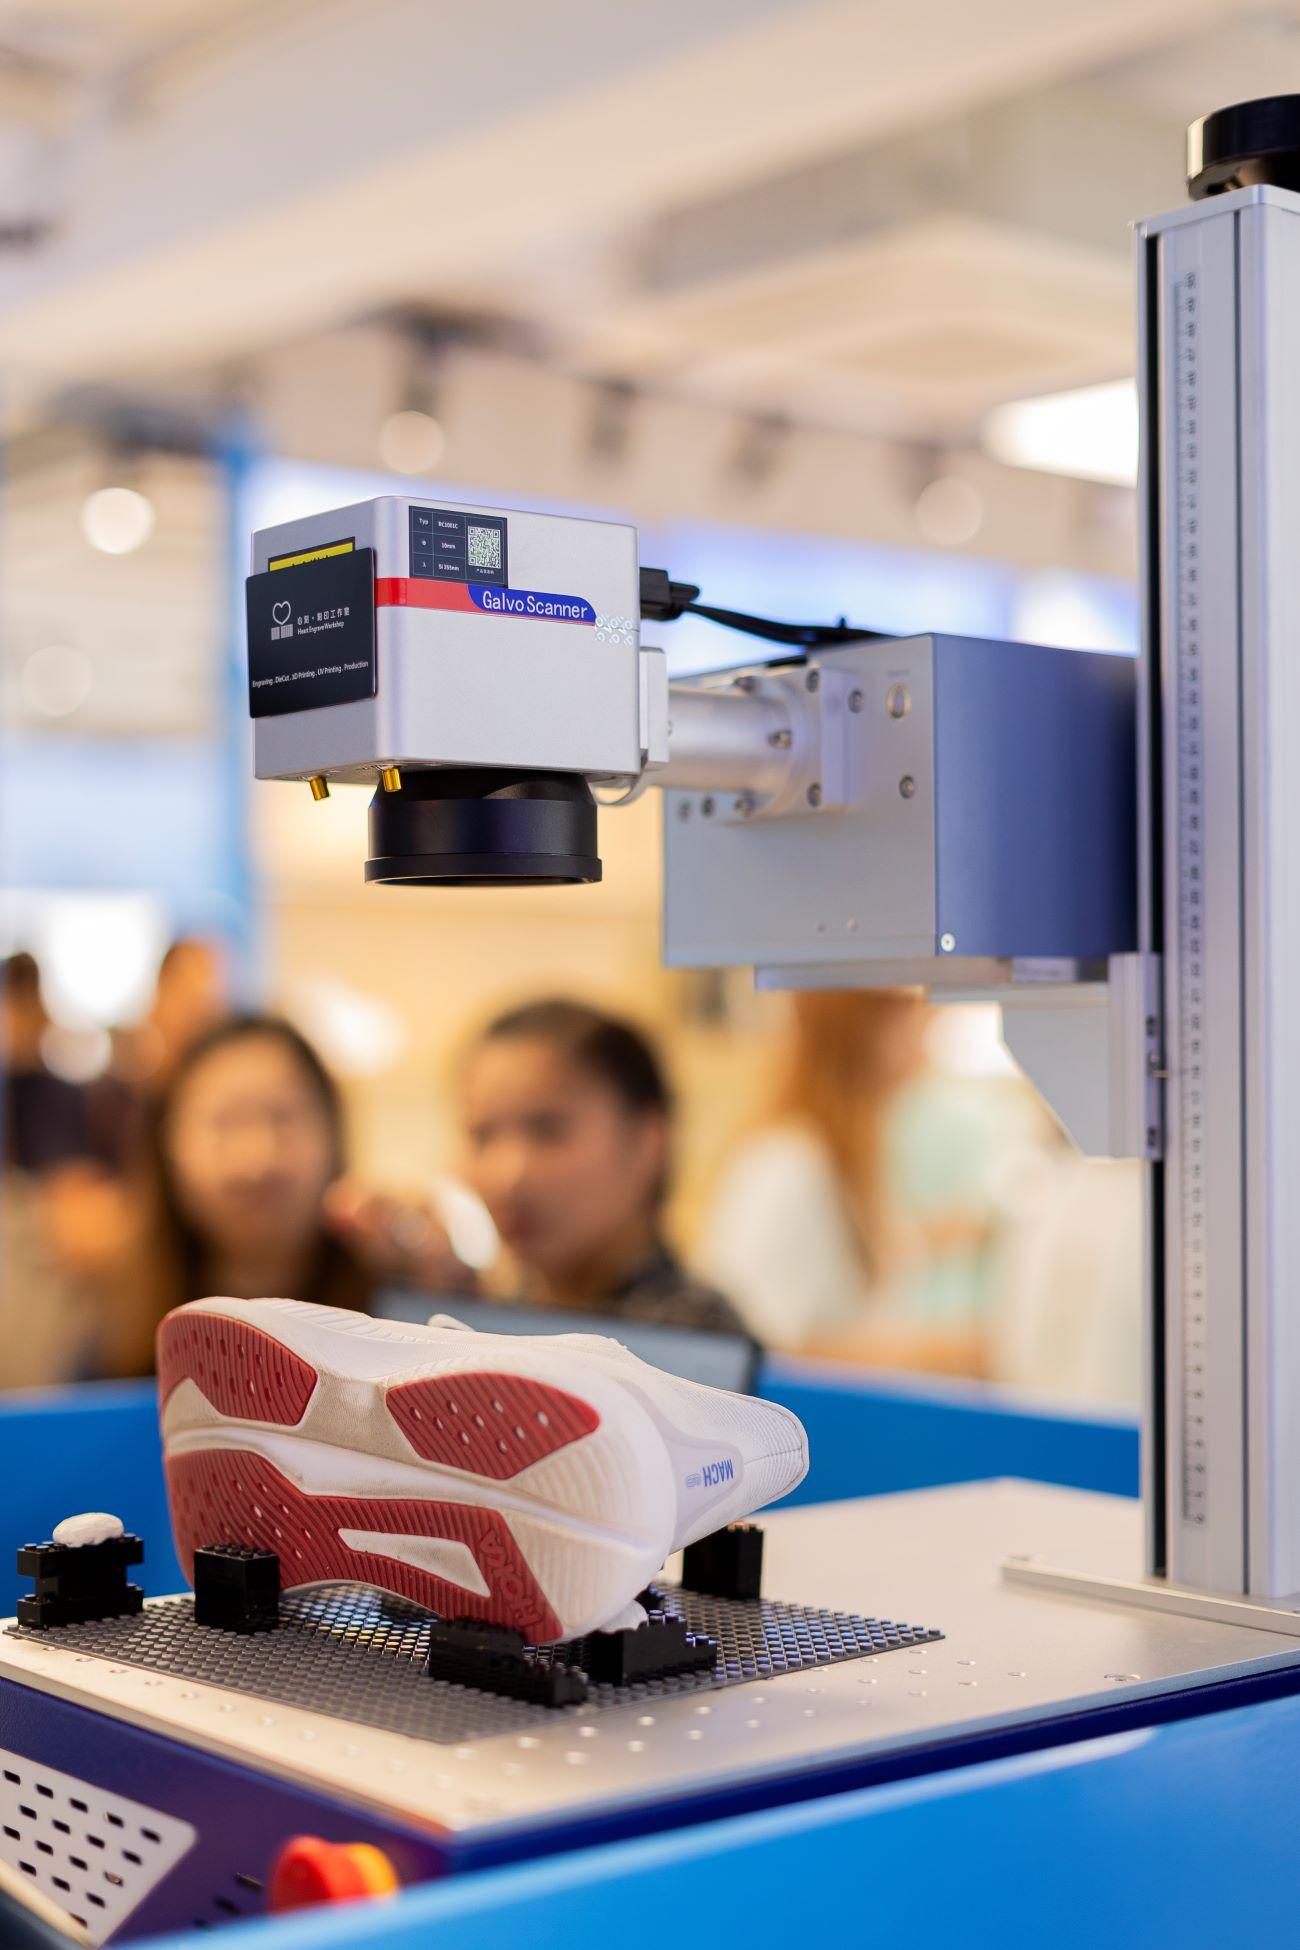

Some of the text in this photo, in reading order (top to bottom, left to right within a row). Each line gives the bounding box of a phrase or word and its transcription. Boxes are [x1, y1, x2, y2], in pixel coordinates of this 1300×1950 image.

[419, 518, 428, 526] Typ
[482, 590, 588, 618] Galvo Scanner
[309, 625, 324, 634] Engrave
[324, 620, 345, 630] Workshop
[252, 678, 273, 688] Engraving
[275, 675, 290, 684] DieCut
[299, 670, 315, 680] Printing
[325, 665, 342, 674] Printing
[344, 661, 369, 670] Production
[702, 1458, 734, 1487] MACH
[479, 1528, 544, 1626] HOKA
